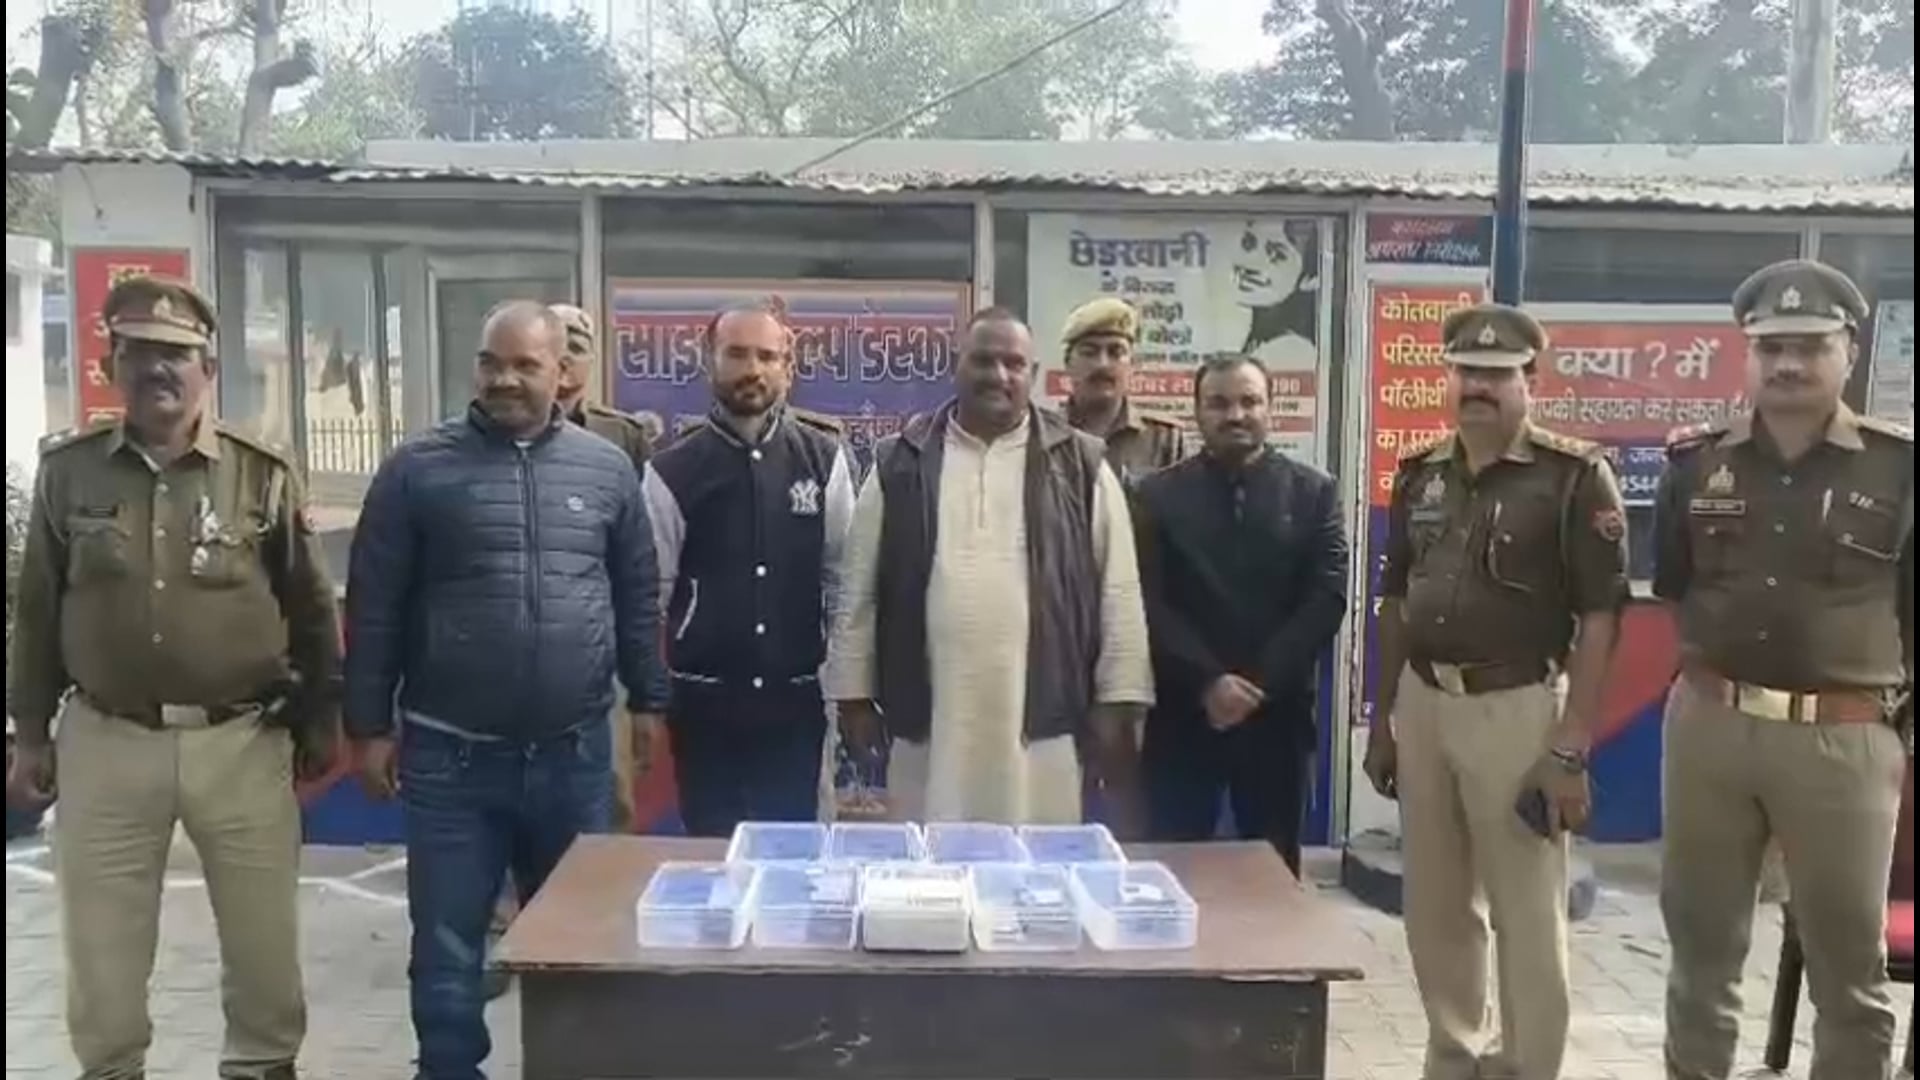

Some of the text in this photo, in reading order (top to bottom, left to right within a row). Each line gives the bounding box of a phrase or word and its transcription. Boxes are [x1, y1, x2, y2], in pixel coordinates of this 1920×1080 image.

[1380, 292, 1474, 323] कोतवाी
[612, 310, 712, 386] साइ
[1555, 347, 1636, 379] क्या
[1645, 340, 1667, 379] ?
[1380, 376, 1449, 409] पॉलीथी
